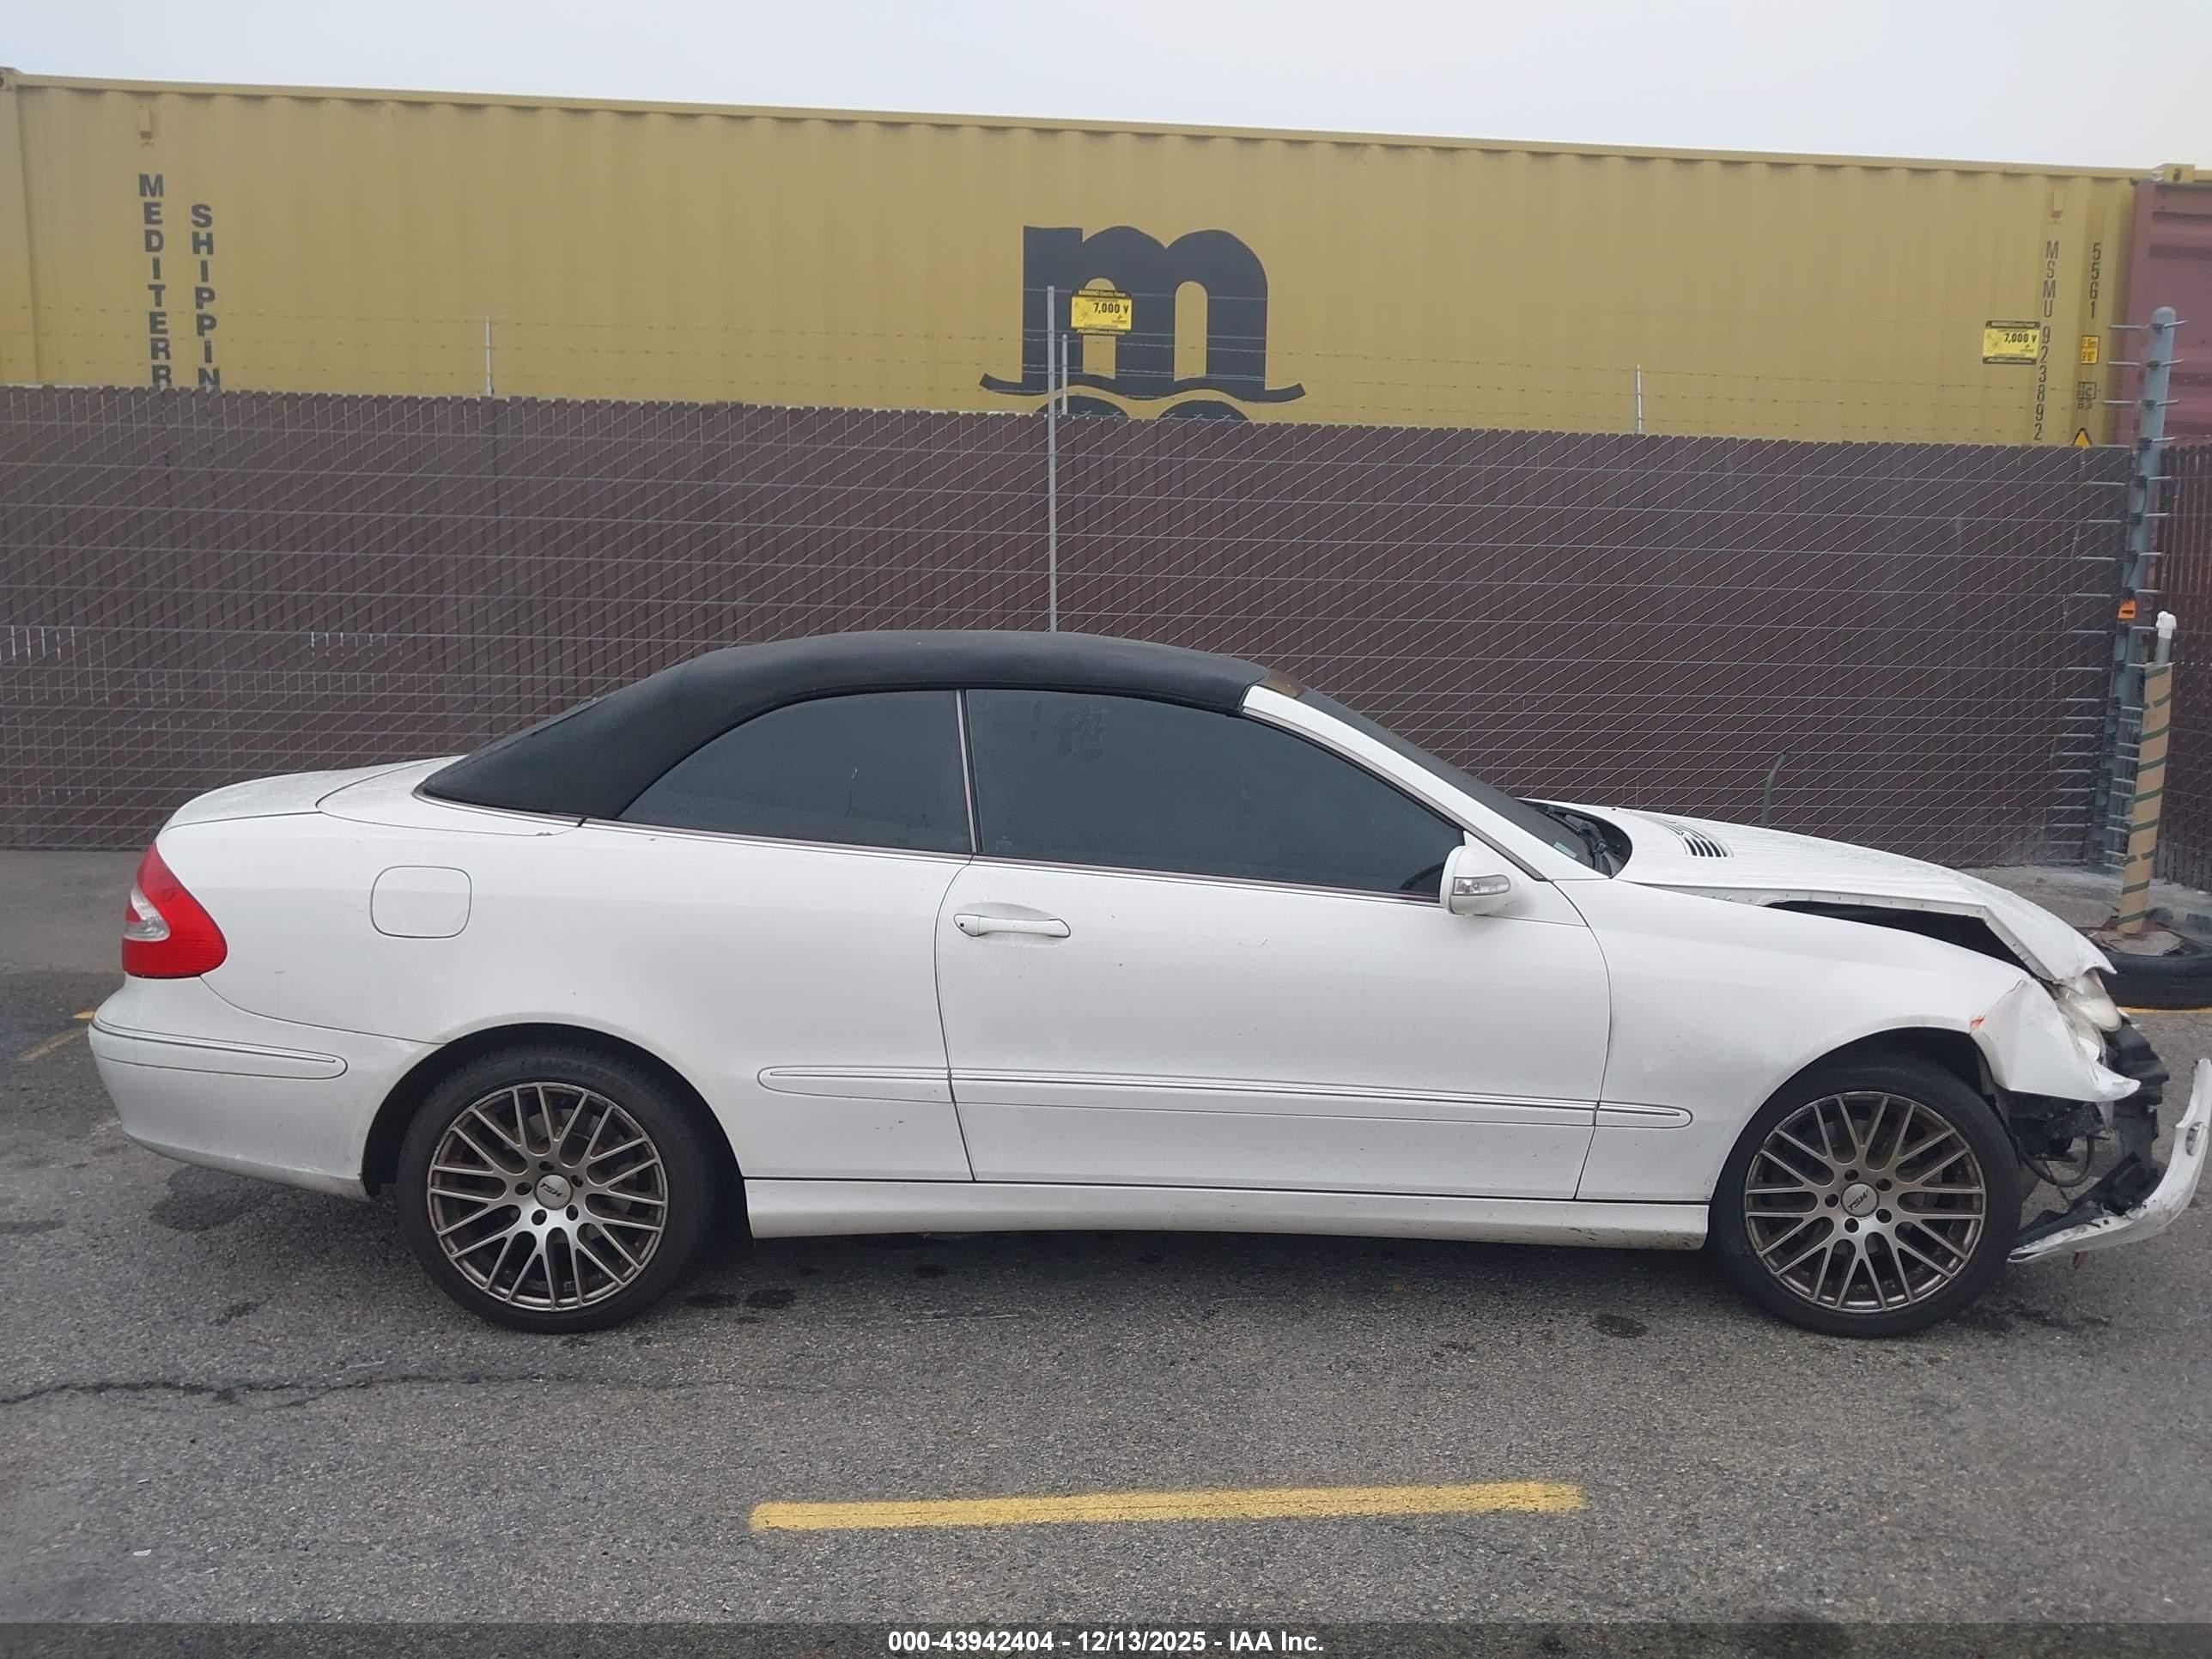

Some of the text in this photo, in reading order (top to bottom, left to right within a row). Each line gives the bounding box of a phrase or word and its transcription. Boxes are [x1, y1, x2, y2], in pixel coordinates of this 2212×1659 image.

[2042, 240, 2059, 318] MSMU
[1093, 302, 1129, 314] 7,000 V
[2004, 332, 2038, 344] 7,000 V
[1847, 1188, 1869, 1211] TSW
